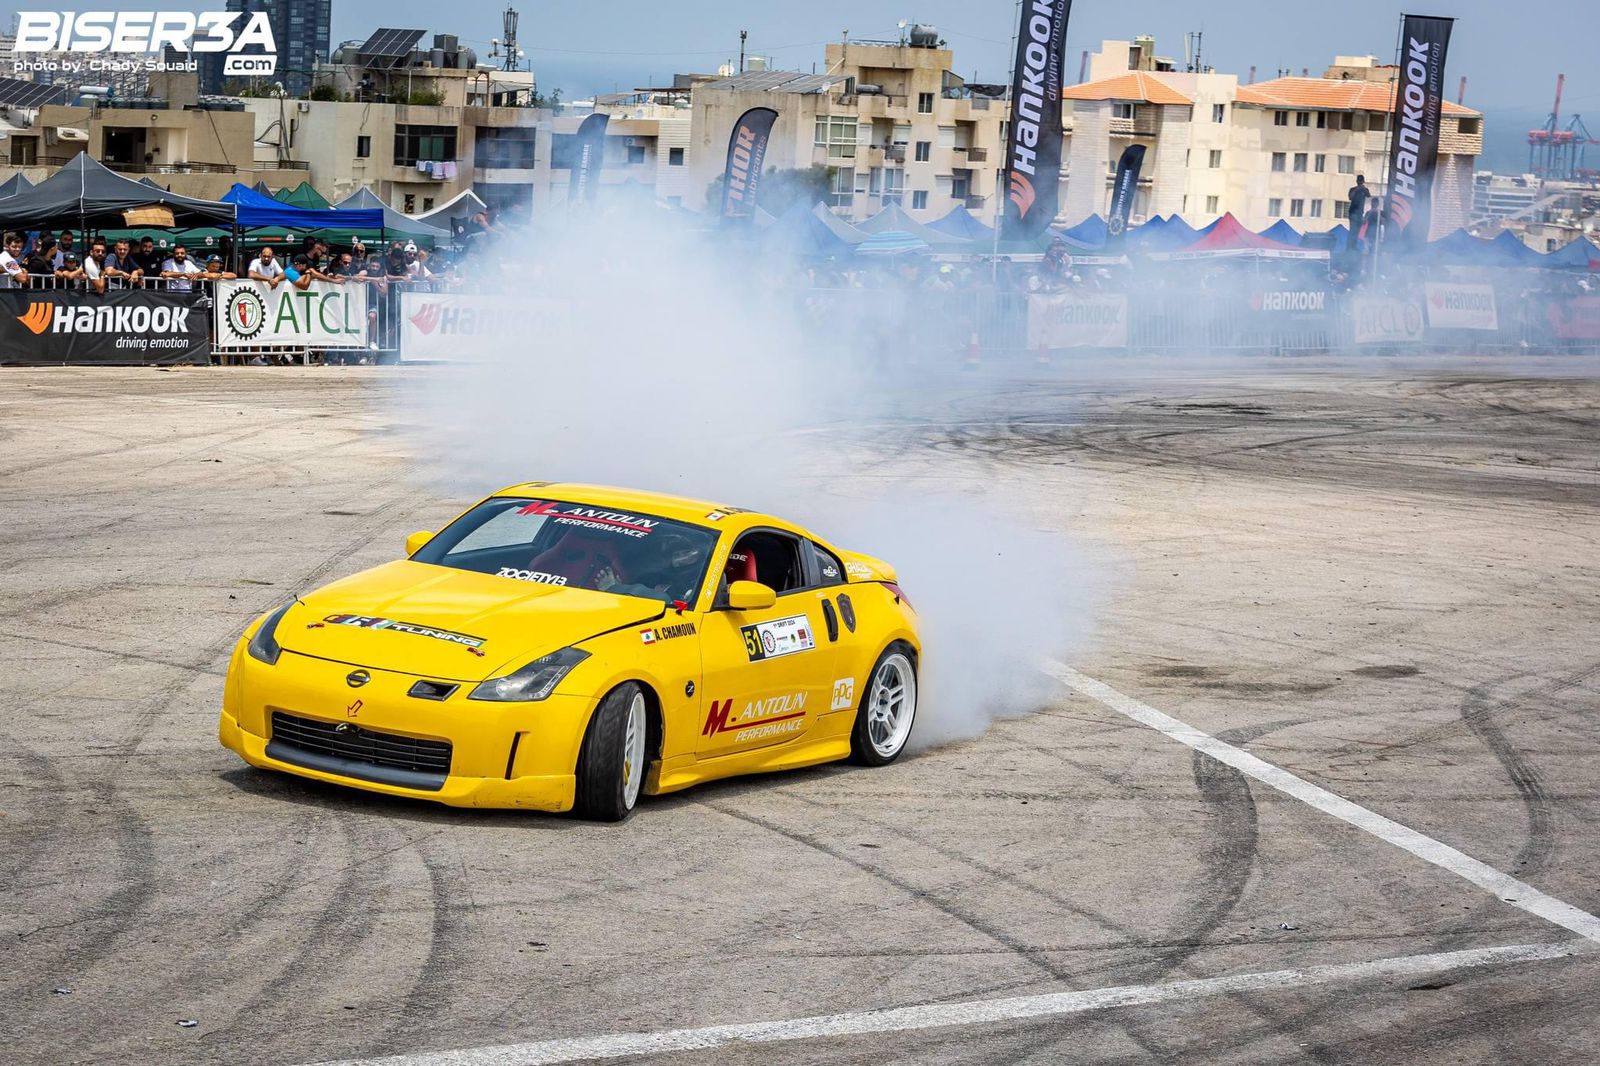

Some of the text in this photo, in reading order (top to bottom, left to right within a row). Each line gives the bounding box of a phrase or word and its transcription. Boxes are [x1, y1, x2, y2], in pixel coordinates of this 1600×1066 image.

[1046, 0, 1065, 101] driving emotio
[1424, 42, 1441, 136] driving emotion
[274, 291, 360, 334] ATCL
[116, 336, 189, 351] driving emotion
[554, 517, 649, 538] PERFORMANCE
[390, 623, 482, 647] TUNING
[661, 622, 697, 640] CHAMOUN
[744, 629, 764, 656] 51
[834, 682, 853, 705] PPG
[734, 718, 804, 743] PERFORMANCE
